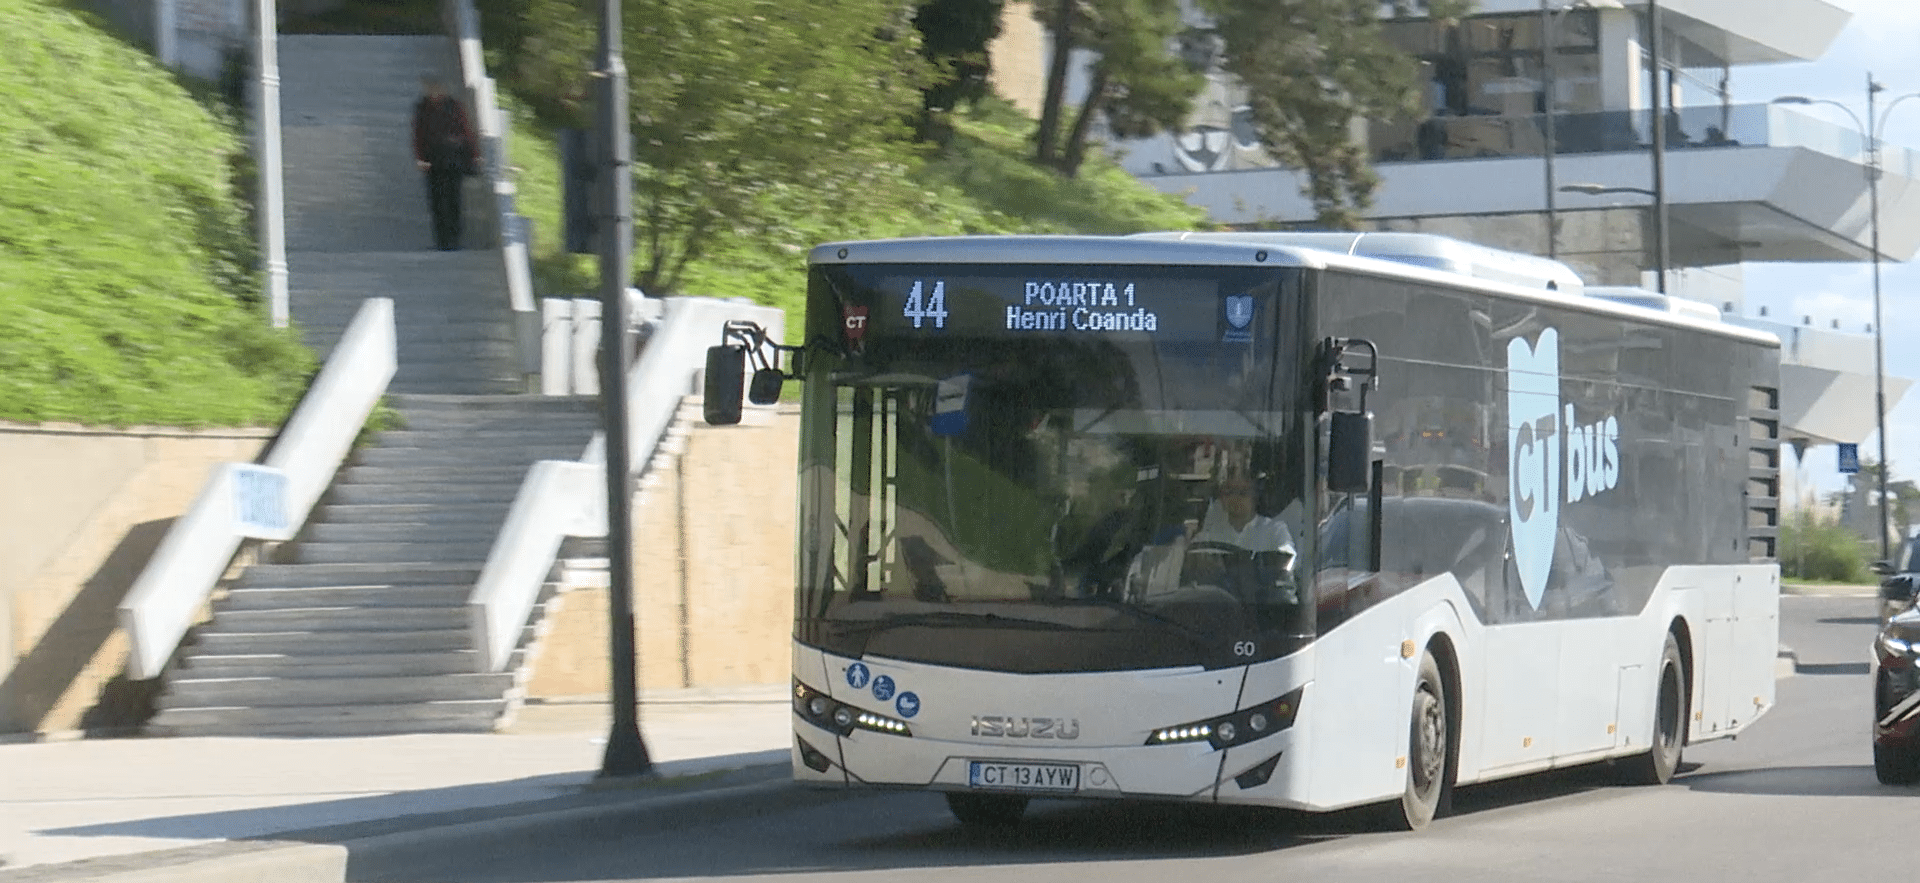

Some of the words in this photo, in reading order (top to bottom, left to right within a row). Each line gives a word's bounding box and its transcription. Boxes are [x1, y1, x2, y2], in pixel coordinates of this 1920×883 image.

[904, 281, 948, 328] 44
[1025, 282, 1118, 306] POARTA
[1124, 283, 1135, 306] 1
[846, 316, 866, 329] CT
[1006, 306, 1067, 330] Henri
[1072, 307, 1157, 331] Coanda
[1513, 413, 1556, 523] CT
[1565, 403, 1619, 504] bus
[1233, 641, 1255, 656] 60
[971, 715, 1080, 740] ISUZU
[984, 766, 1007, 784] CT
[1015, 767, 1031, 785] 13
[1034, 767, 1073, 787] AYW
